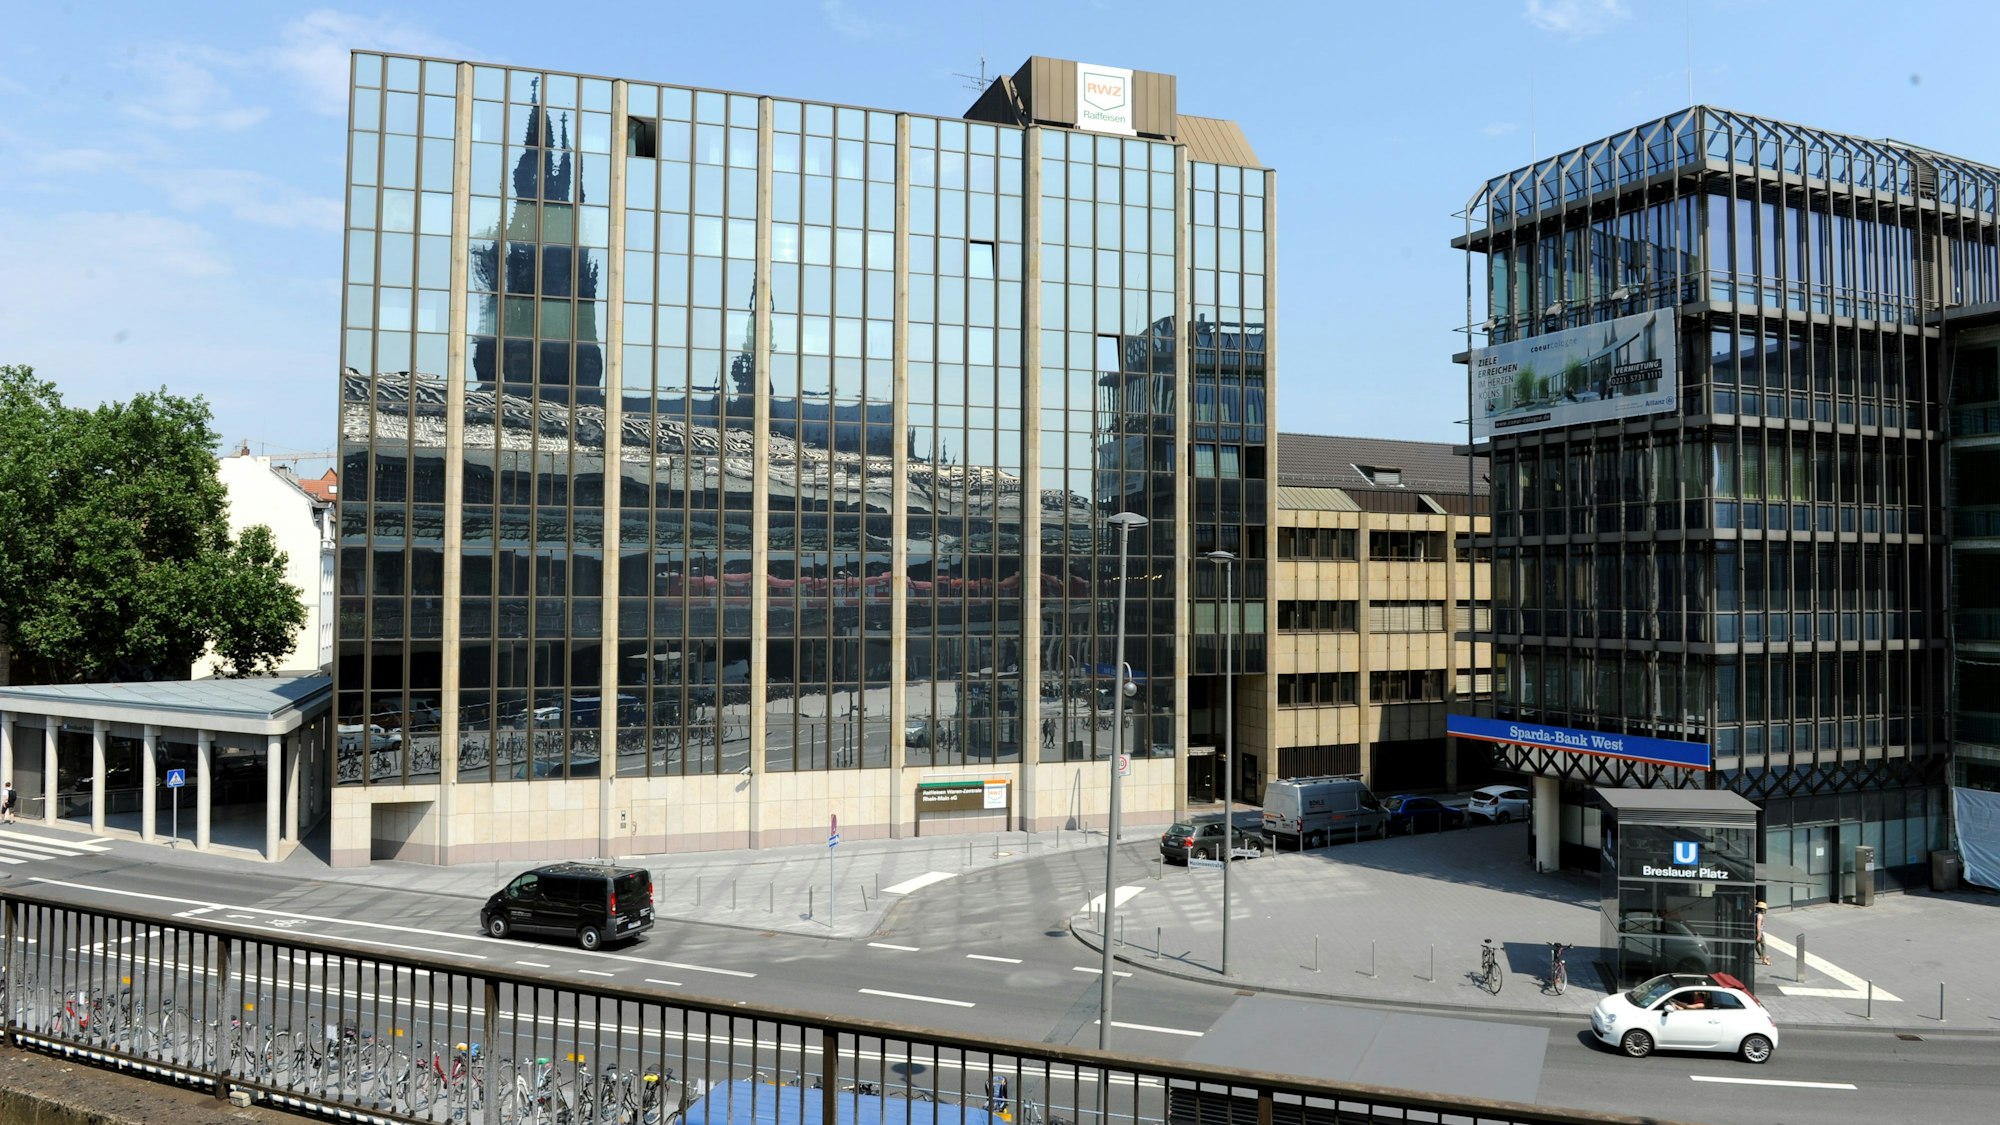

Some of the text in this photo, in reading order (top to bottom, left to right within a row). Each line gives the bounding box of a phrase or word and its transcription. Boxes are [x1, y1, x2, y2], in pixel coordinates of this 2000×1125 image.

[1087, 83, 1121, 96] RWZ
[1083, 110, 1126, 123] Raiffeisen
[1478, 356, 1498, 367] ZIELE
[1478, 363, 1518, 378] ERREICHEN
[1630, 372, 1645, 382] 5731
[1647, 370, 1662, 379] 1111
[1487, 375, 1514, 387] HERZEN
[1645, 399, 1665, 407] Allianz
[1509, 725, 1624, 751] Sparda-Bank West
[1675, 842, 1696, 863] U
[1643, 865, 1729, 880] Breslauer Platz
